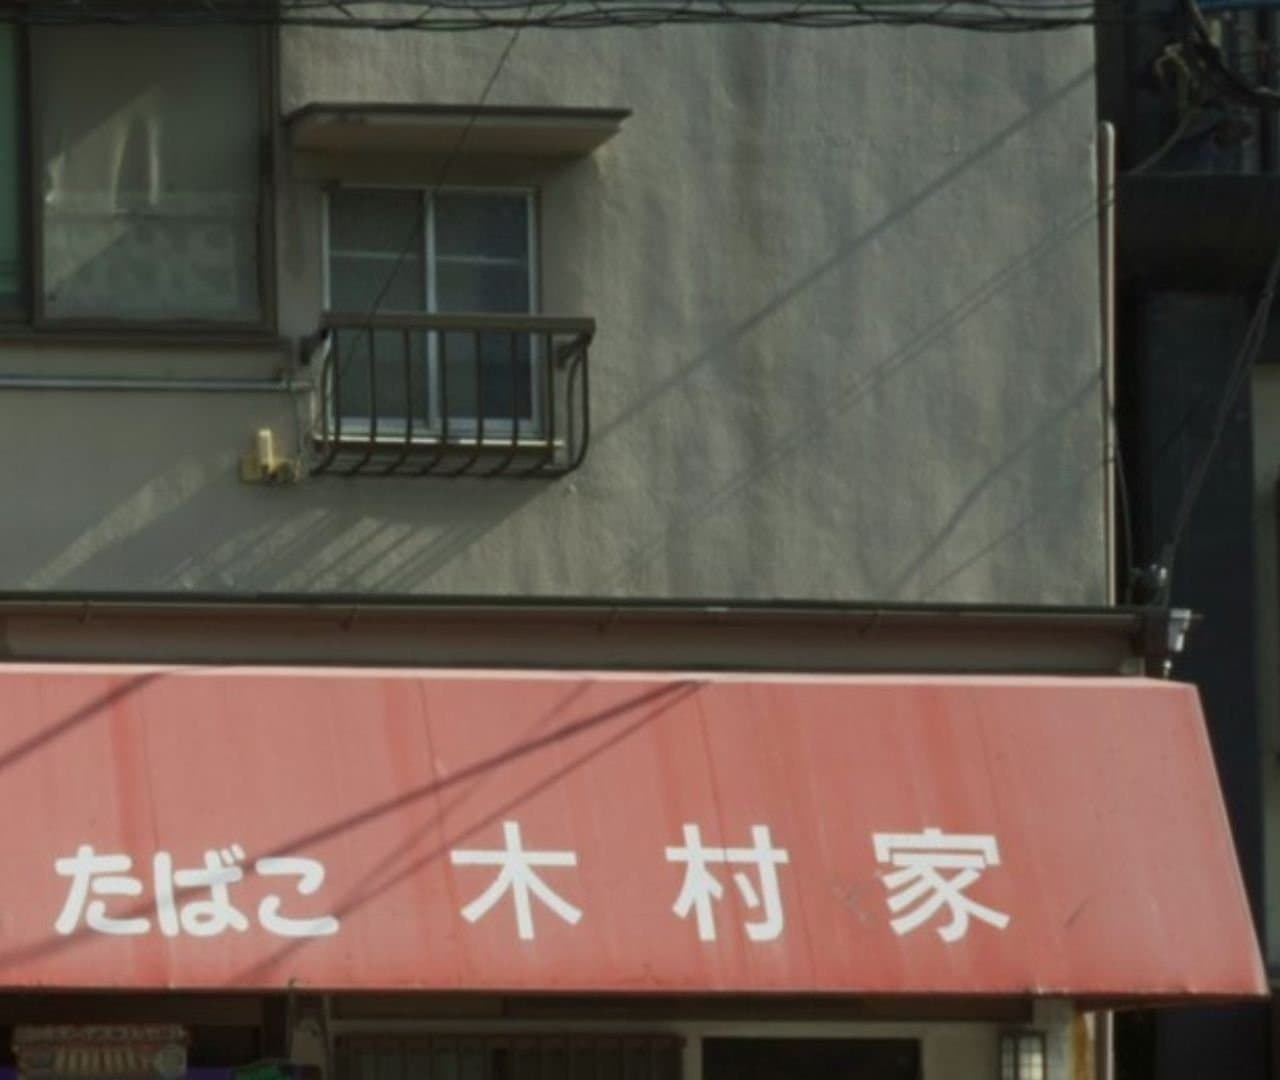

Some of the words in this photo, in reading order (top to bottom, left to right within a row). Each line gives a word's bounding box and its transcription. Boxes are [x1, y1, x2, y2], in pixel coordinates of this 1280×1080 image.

[53, 844, 341, 939] たばこ
[449, 820, 1012, 942] 木村家
